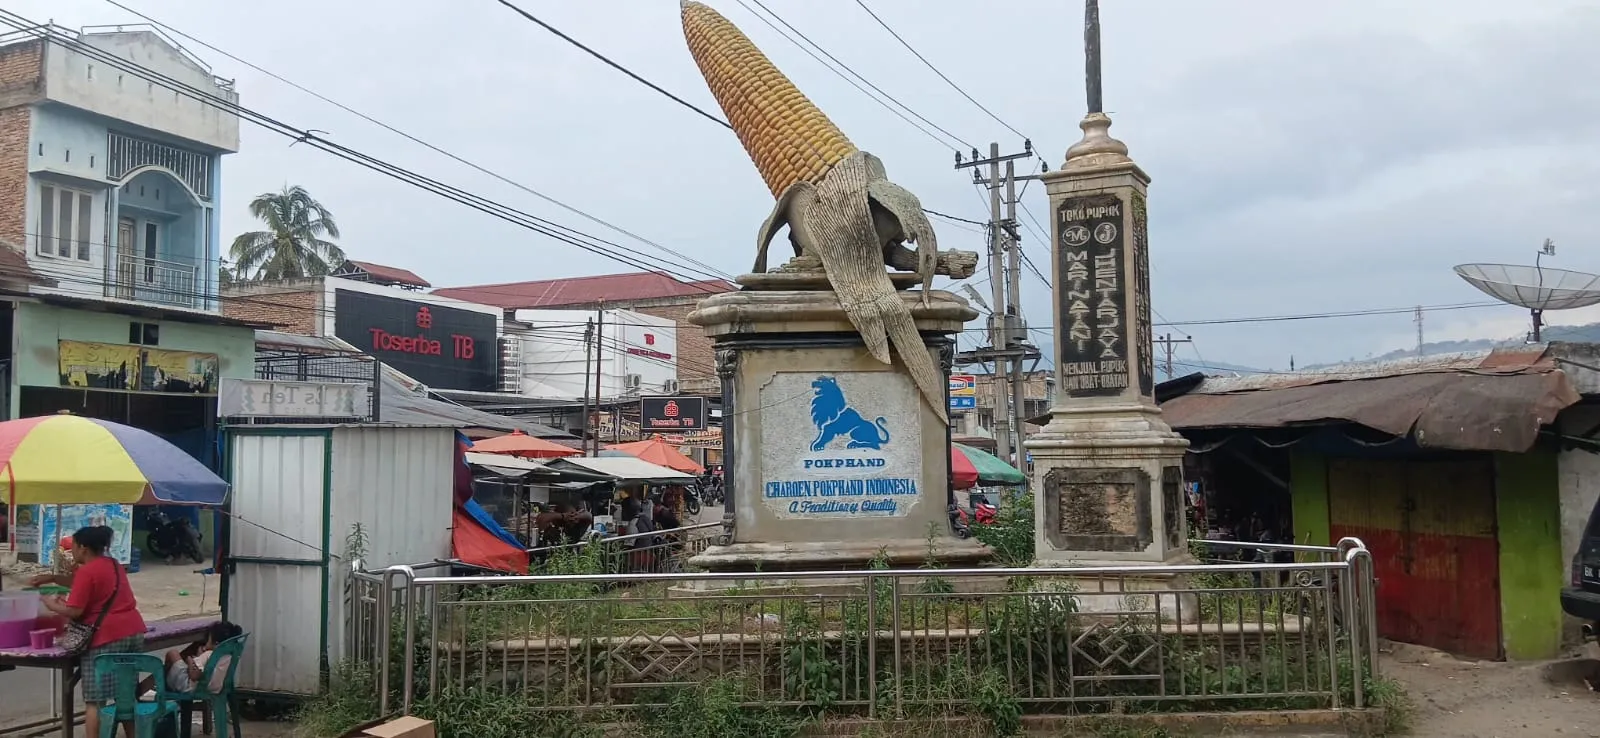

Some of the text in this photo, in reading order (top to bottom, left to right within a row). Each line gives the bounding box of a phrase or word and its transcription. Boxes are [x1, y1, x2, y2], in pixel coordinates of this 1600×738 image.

[1060, 206, 1085, 222] TOKO
[368, 328, 474, 359] Toserba TB
[1062, 359, 1126, 375] MENJUAL PUPUK
[682, 417, 694, 426] TB
[804, 458, 885, 469] POKPHAND
[766, 478, 917, 498] CHAROEN POKPHAND INDONESIA
[861, 498, 897, 515] Quality
